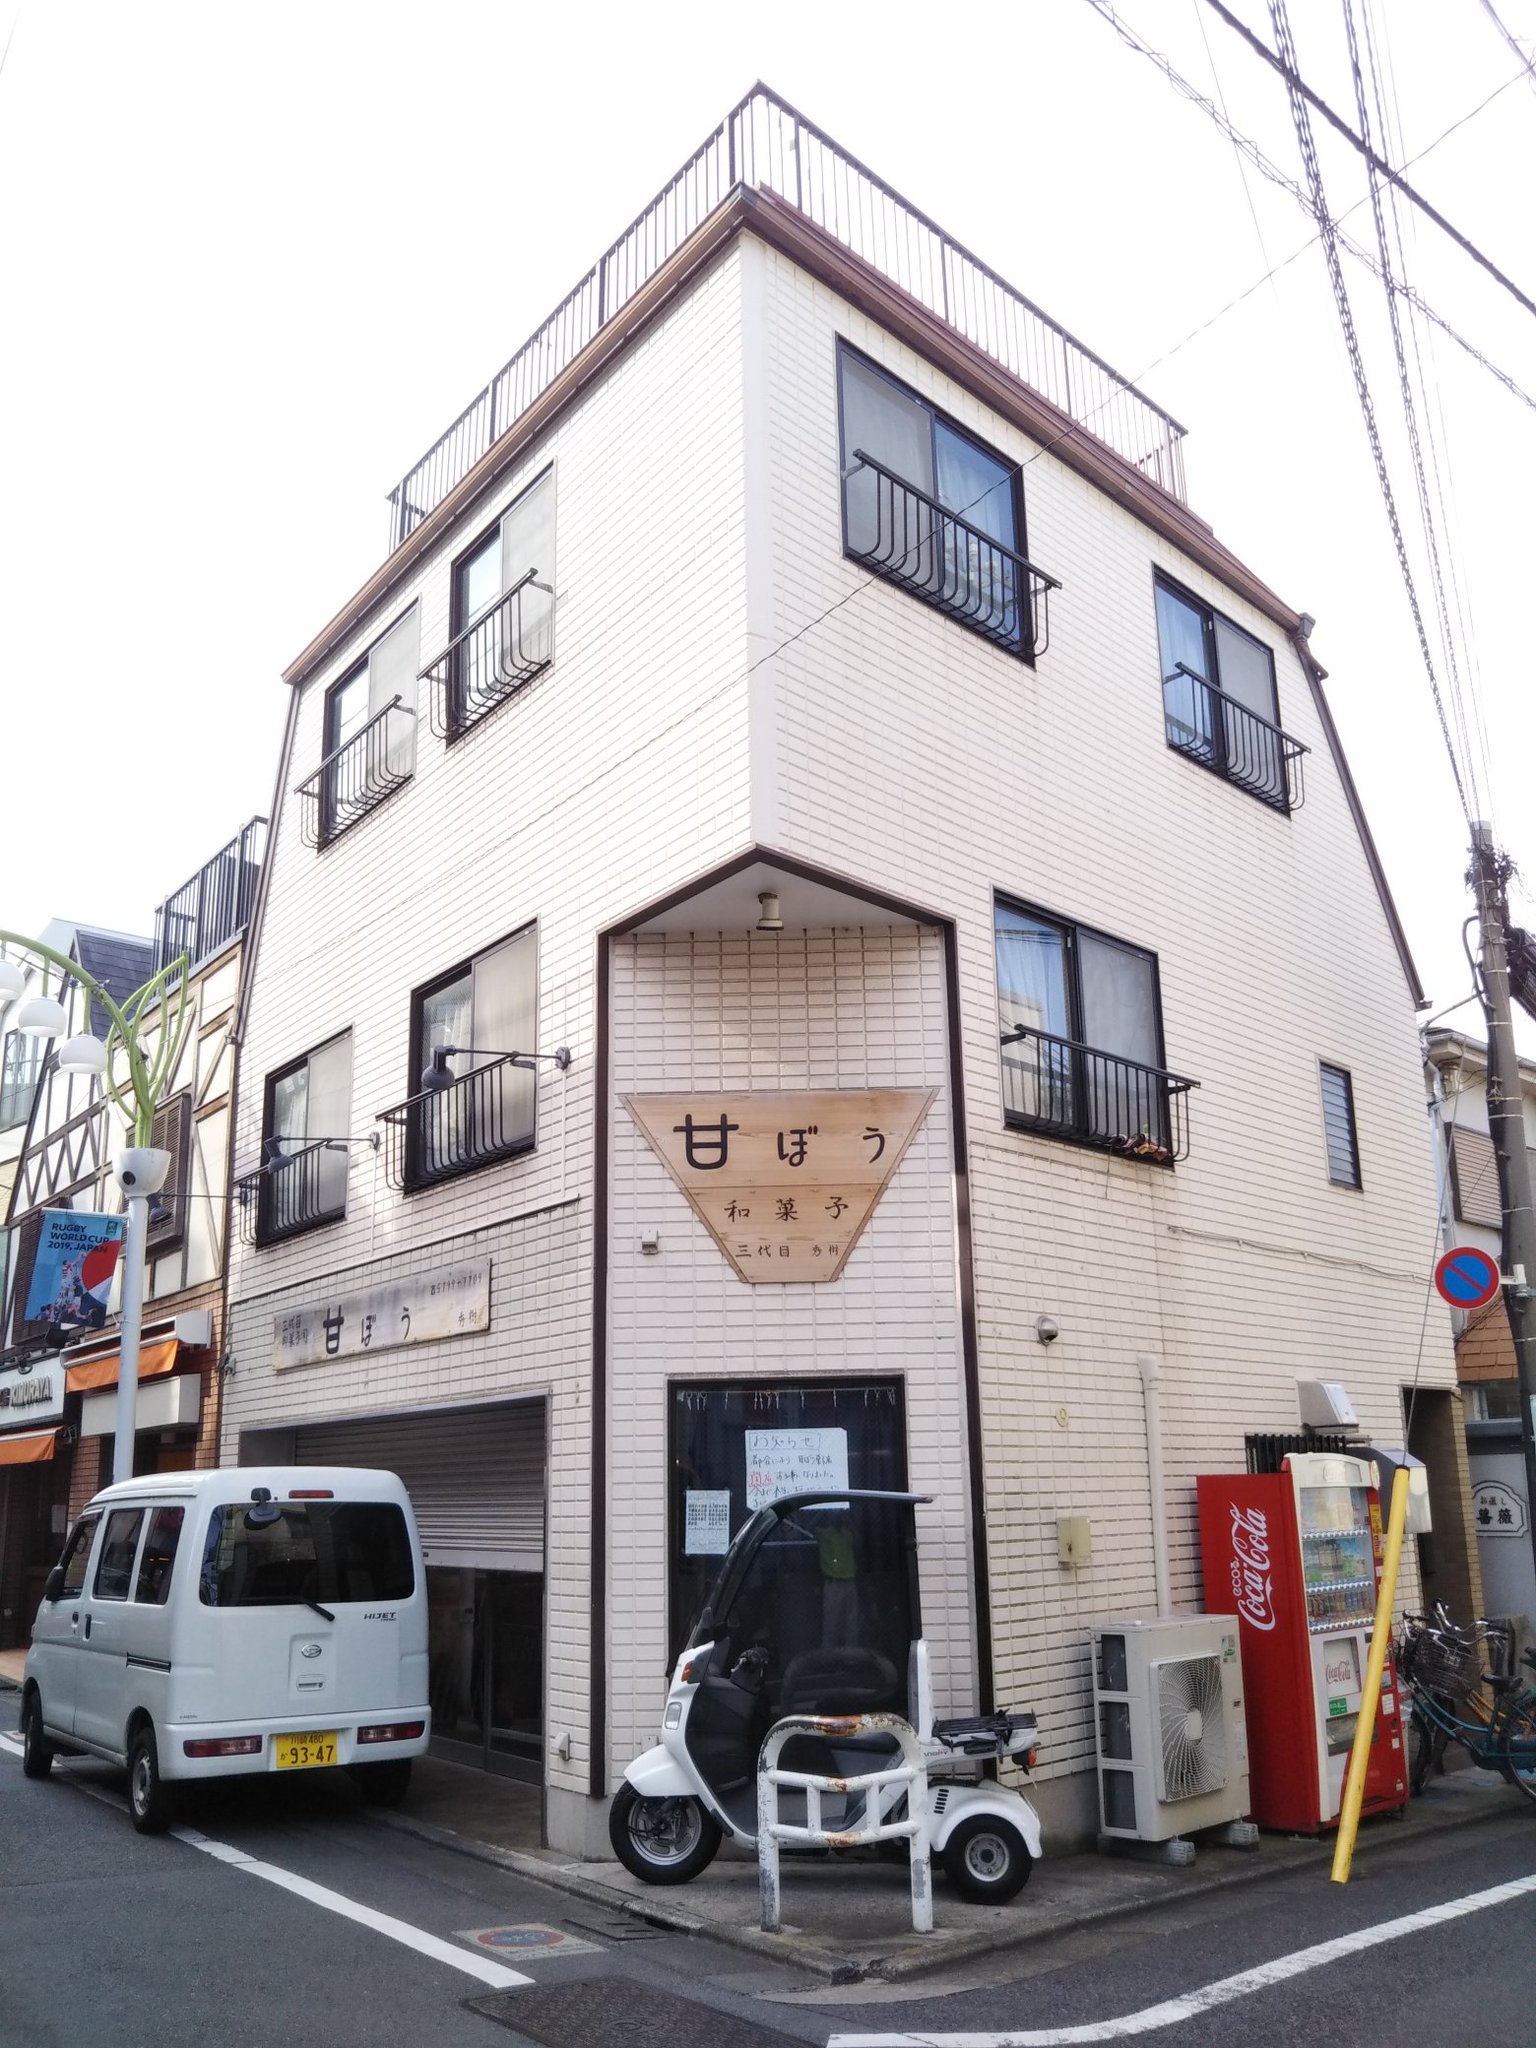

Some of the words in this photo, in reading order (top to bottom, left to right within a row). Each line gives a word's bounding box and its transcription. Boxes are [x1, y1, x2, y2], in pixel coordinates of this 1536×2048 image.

[673, 1113, 885, 1170] 甘ぼう
[724, 1196, 849, 1221] 和菓子
[52, 1223, 87, 1232] RUGBY
[50, 1232, 87, 1242] WORLD
[88, 1235, 110, 1244] CUP
[47, 1241, 72, 1251] 2019,
[74, 1242, 108, 1253] JAPAN
[735, 1244, 790, 1258] 三代目
[323, 1304, 411, 1354] 甘ぼう
[753, 1435, 815, 1449] お知らせ
[1229, 1500, 1276, 1631] Coca-Cola
[363, 1611, 397, 1620] HIJET
[309, 1733, 324, 1744] 480
[290, 1744, 335, 1765] 93-47
